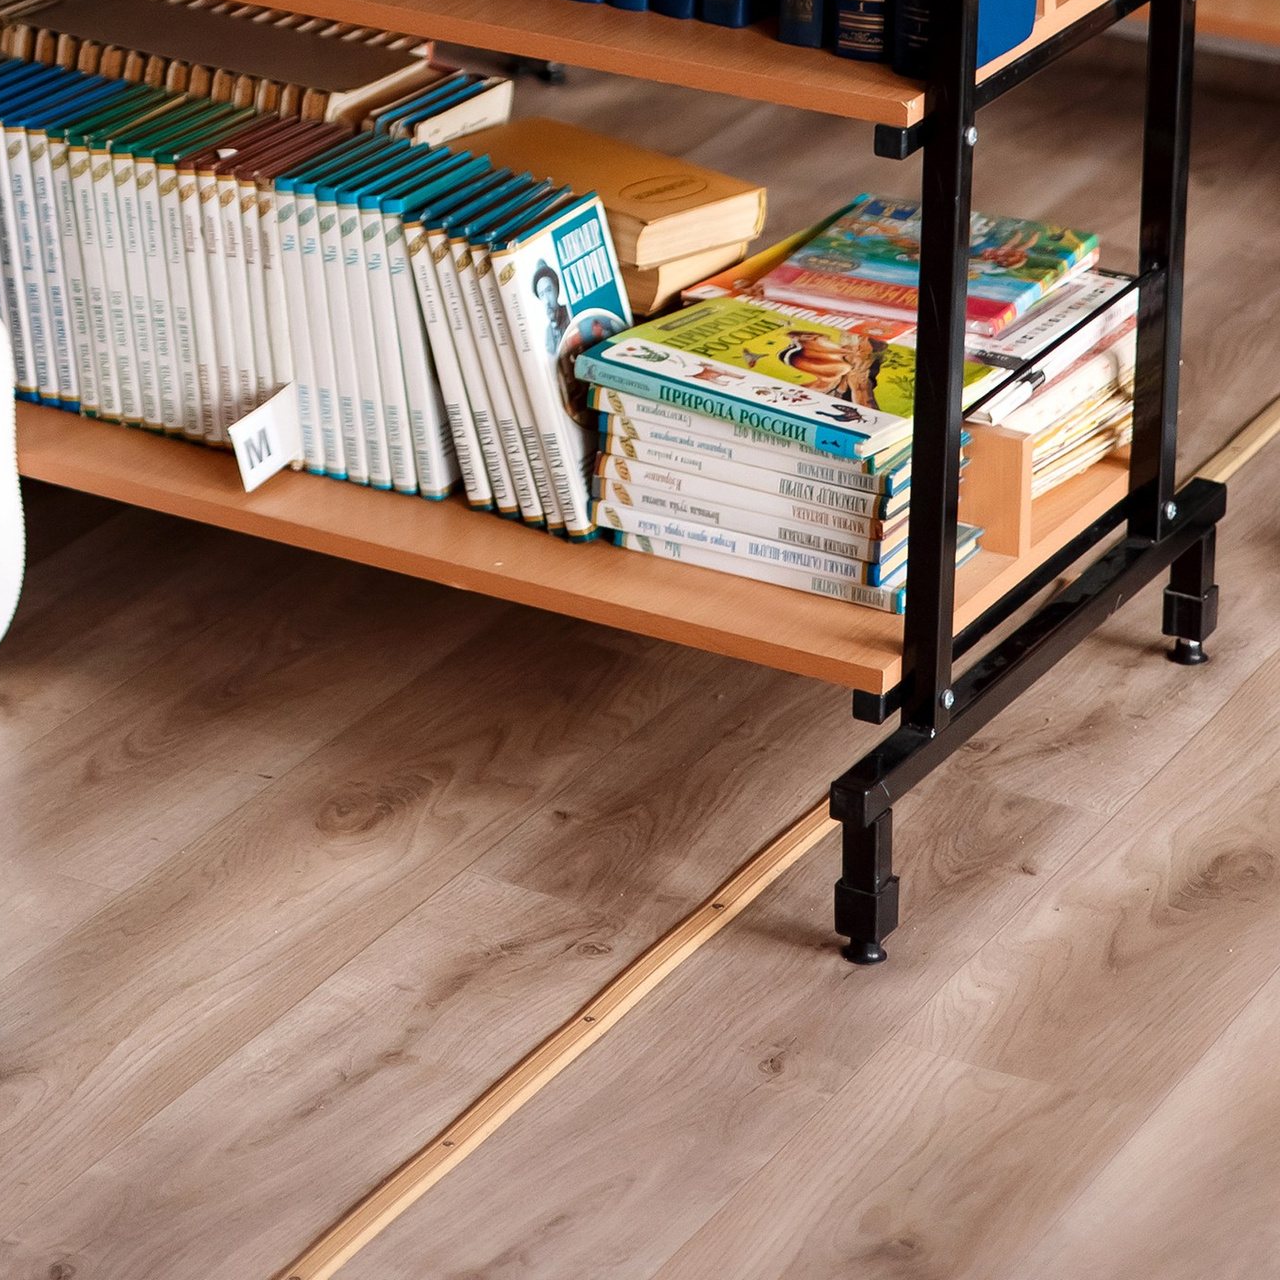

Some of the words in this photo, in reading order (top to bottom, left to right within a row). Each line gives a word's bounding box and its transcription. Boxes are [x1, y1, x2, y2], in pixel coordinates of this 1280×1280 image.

[281, 233, 297, 252] Мы
[302, 236, 318, 255] Мы
[367, 252, 383, 271] Мы
[390, 256, 406, 274] Мы
[691, 319, 786, 358] РОССИИ
[445, 400, 466, 440] КУПРИН
[658, 385, 735, 421] ПРИРОДА
[739, 407, 808, 442] РОССИИ
[473, 408, 495, 447] КУПРИН
[243, 430, 273, 470] М
[542, 431, 563, 469] КУПРИН
[779, 478, 814, 502] КУПРИН
[817, 486, 869, 514] АЛЕКСАНДР
[791, 505, 830, 525] ЦВЕТАЕВА
[831, 514, 865, 535] МАРИНА
[823, 558, 857, 578] МИХАИЛ
